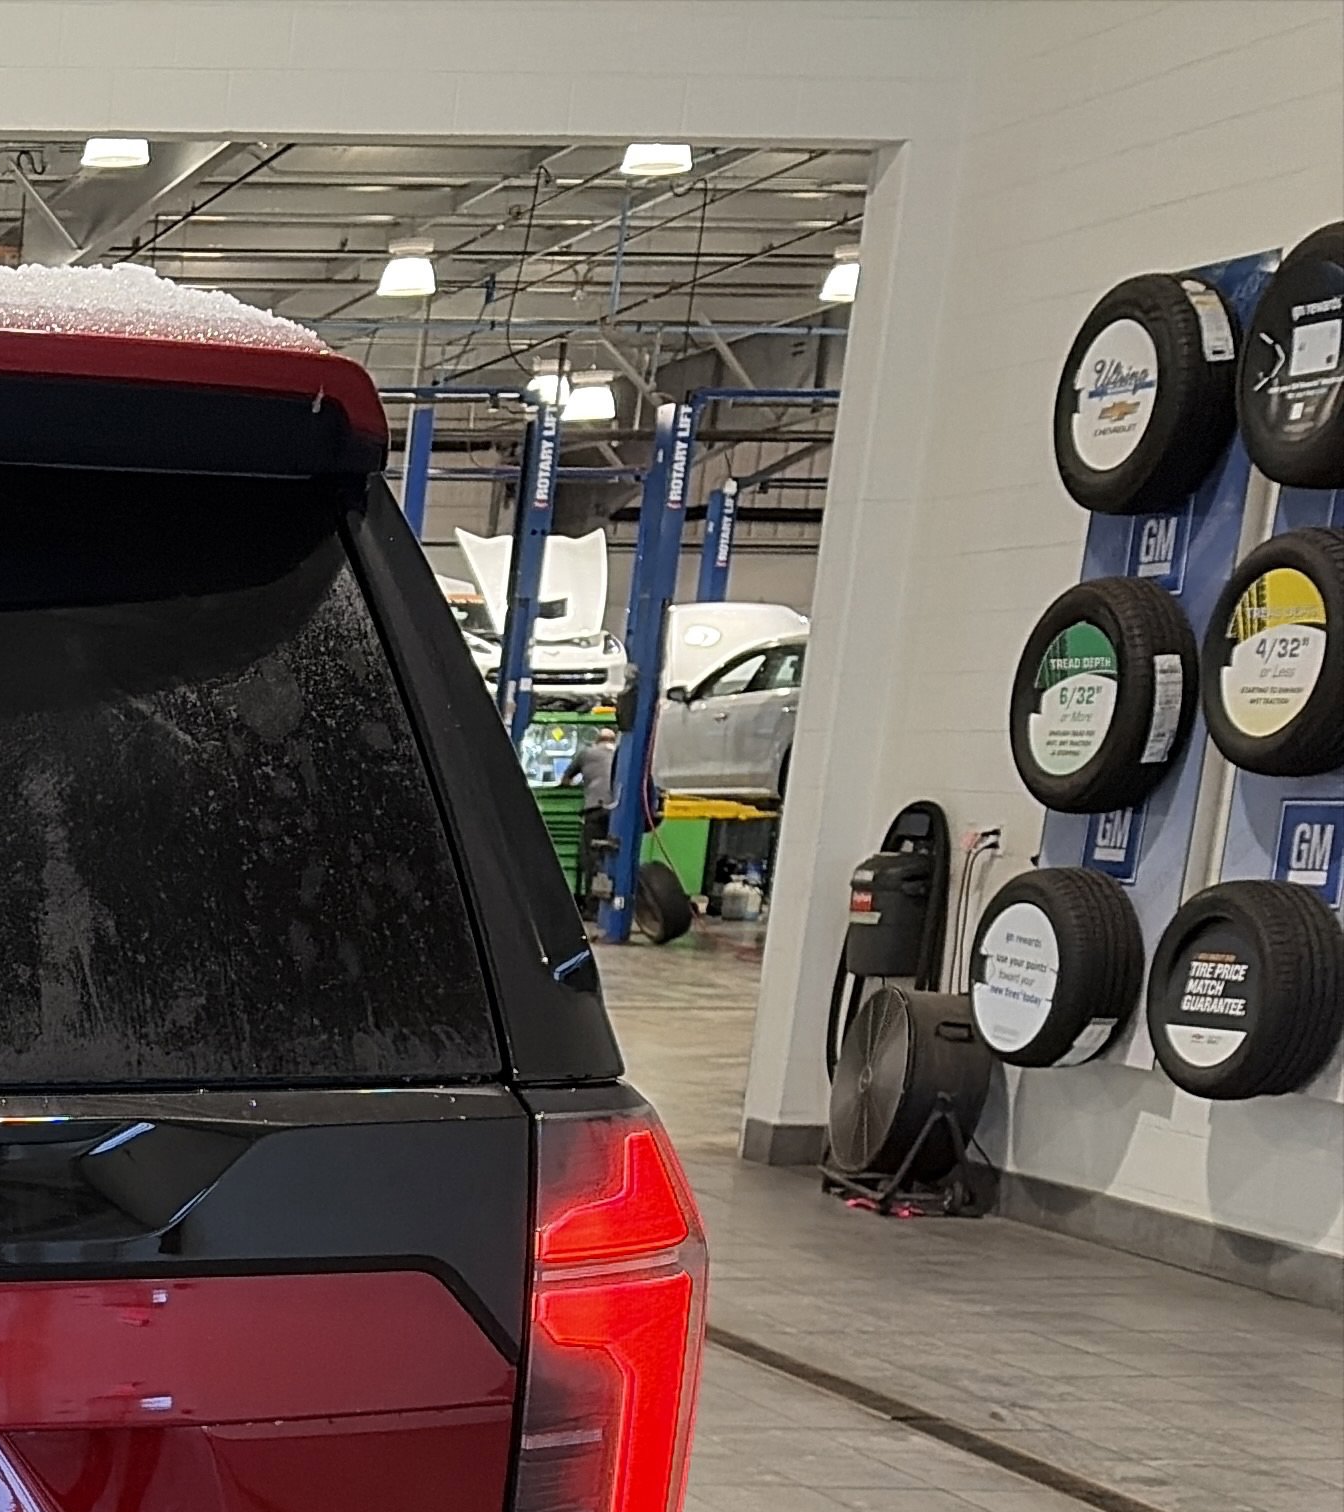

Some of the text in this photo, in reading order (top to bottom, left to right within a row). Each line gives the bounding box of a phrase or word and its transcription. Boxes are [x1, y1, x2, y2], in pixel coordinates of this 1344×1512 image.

[1094, 423, 1137, 437] CHEVROLET
[535, 405, 558, 501] ROTARY LIFT
[668, 405, 693, 501] ROTARY LIFT
[717, 515, 733, 561] ROTARY
[1139, 516, 1178, 563] GM
[1256, 637, 1310, 664] 4/32"
[1049, 656, 1112, 670] TREAD DEPTH
[1272, 665, 1297, 678] Less
[1059, 686, 1103, 710] 6/32"
[1095, 806, 1133, 848] GM
[1290, 822, 1335, 870] GM
[996, 953, 1048, 973] use your points
[1189, 961, 1249, 981] TIRE PRICE
[989, 985, 1004, 995] new
[1022, 993, 1042, 1008] today
[1185, 978, 1226, 996] MATCH
